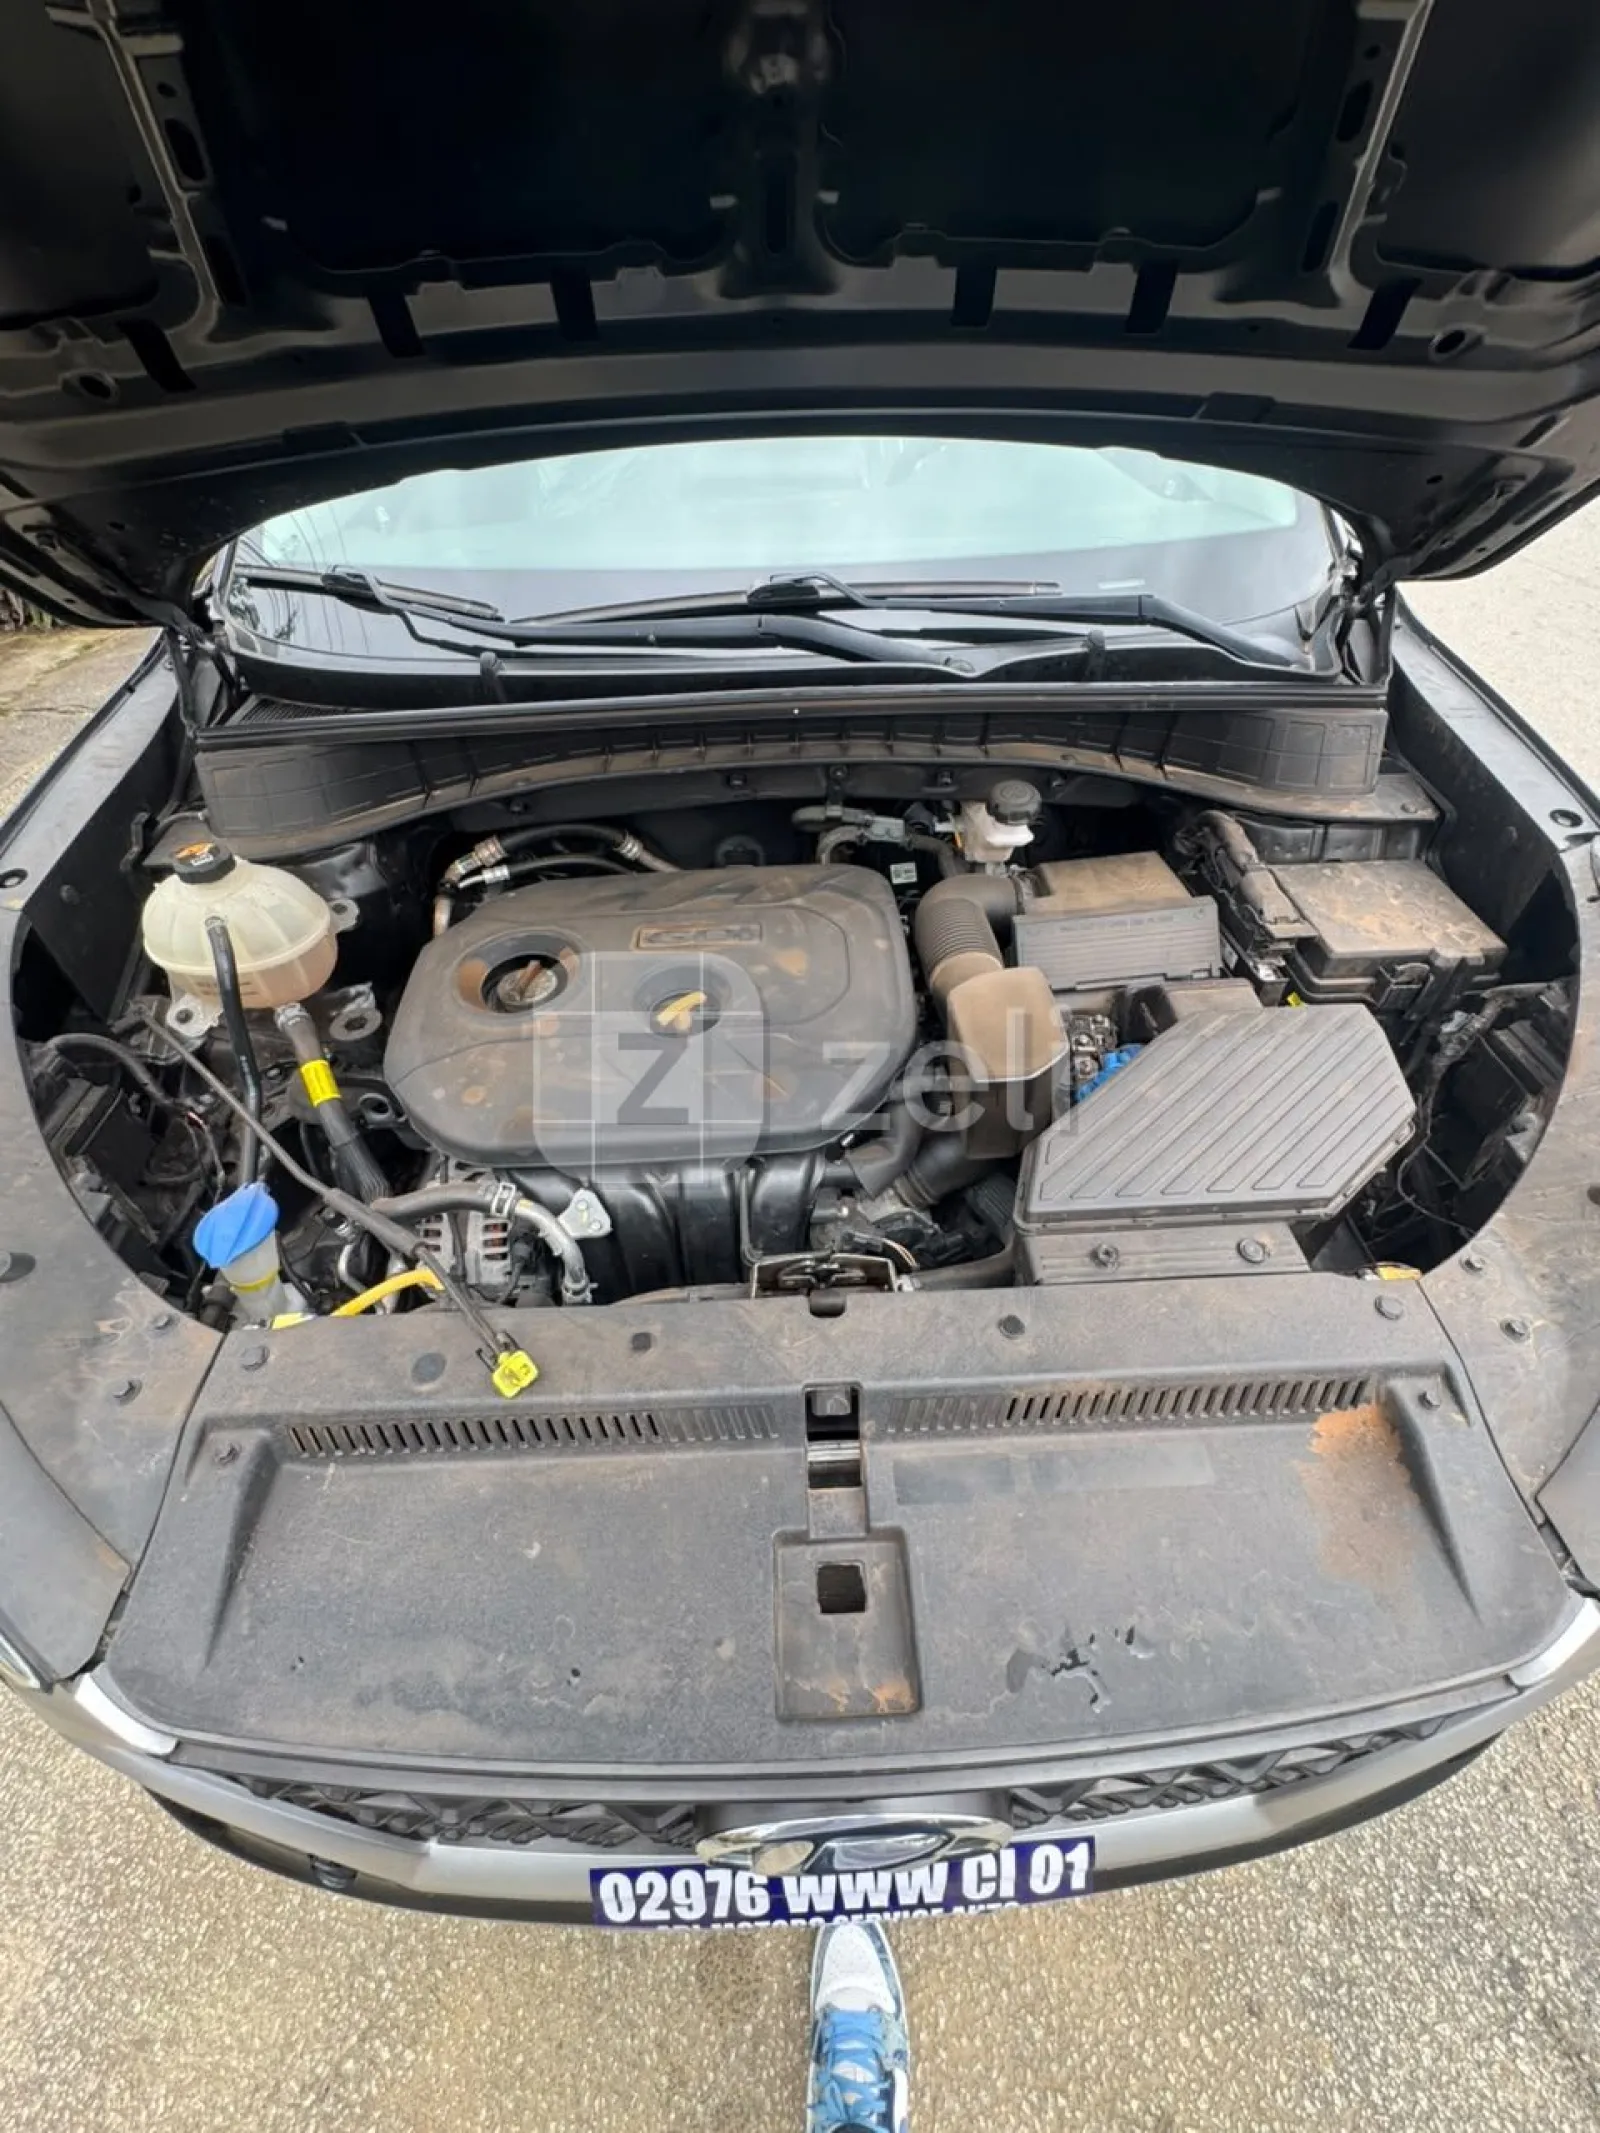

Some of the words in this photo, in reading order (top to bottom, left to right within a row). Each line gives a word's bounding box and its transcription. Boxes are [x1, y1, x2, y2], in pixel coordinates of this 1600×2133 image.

[600, 1868, 771, 1922] 02976
[783, 1862, 949, 1914] WWW
[961, 1848, 1016, 1900] CI
[1030, 1841, 1090, 1894] 01
